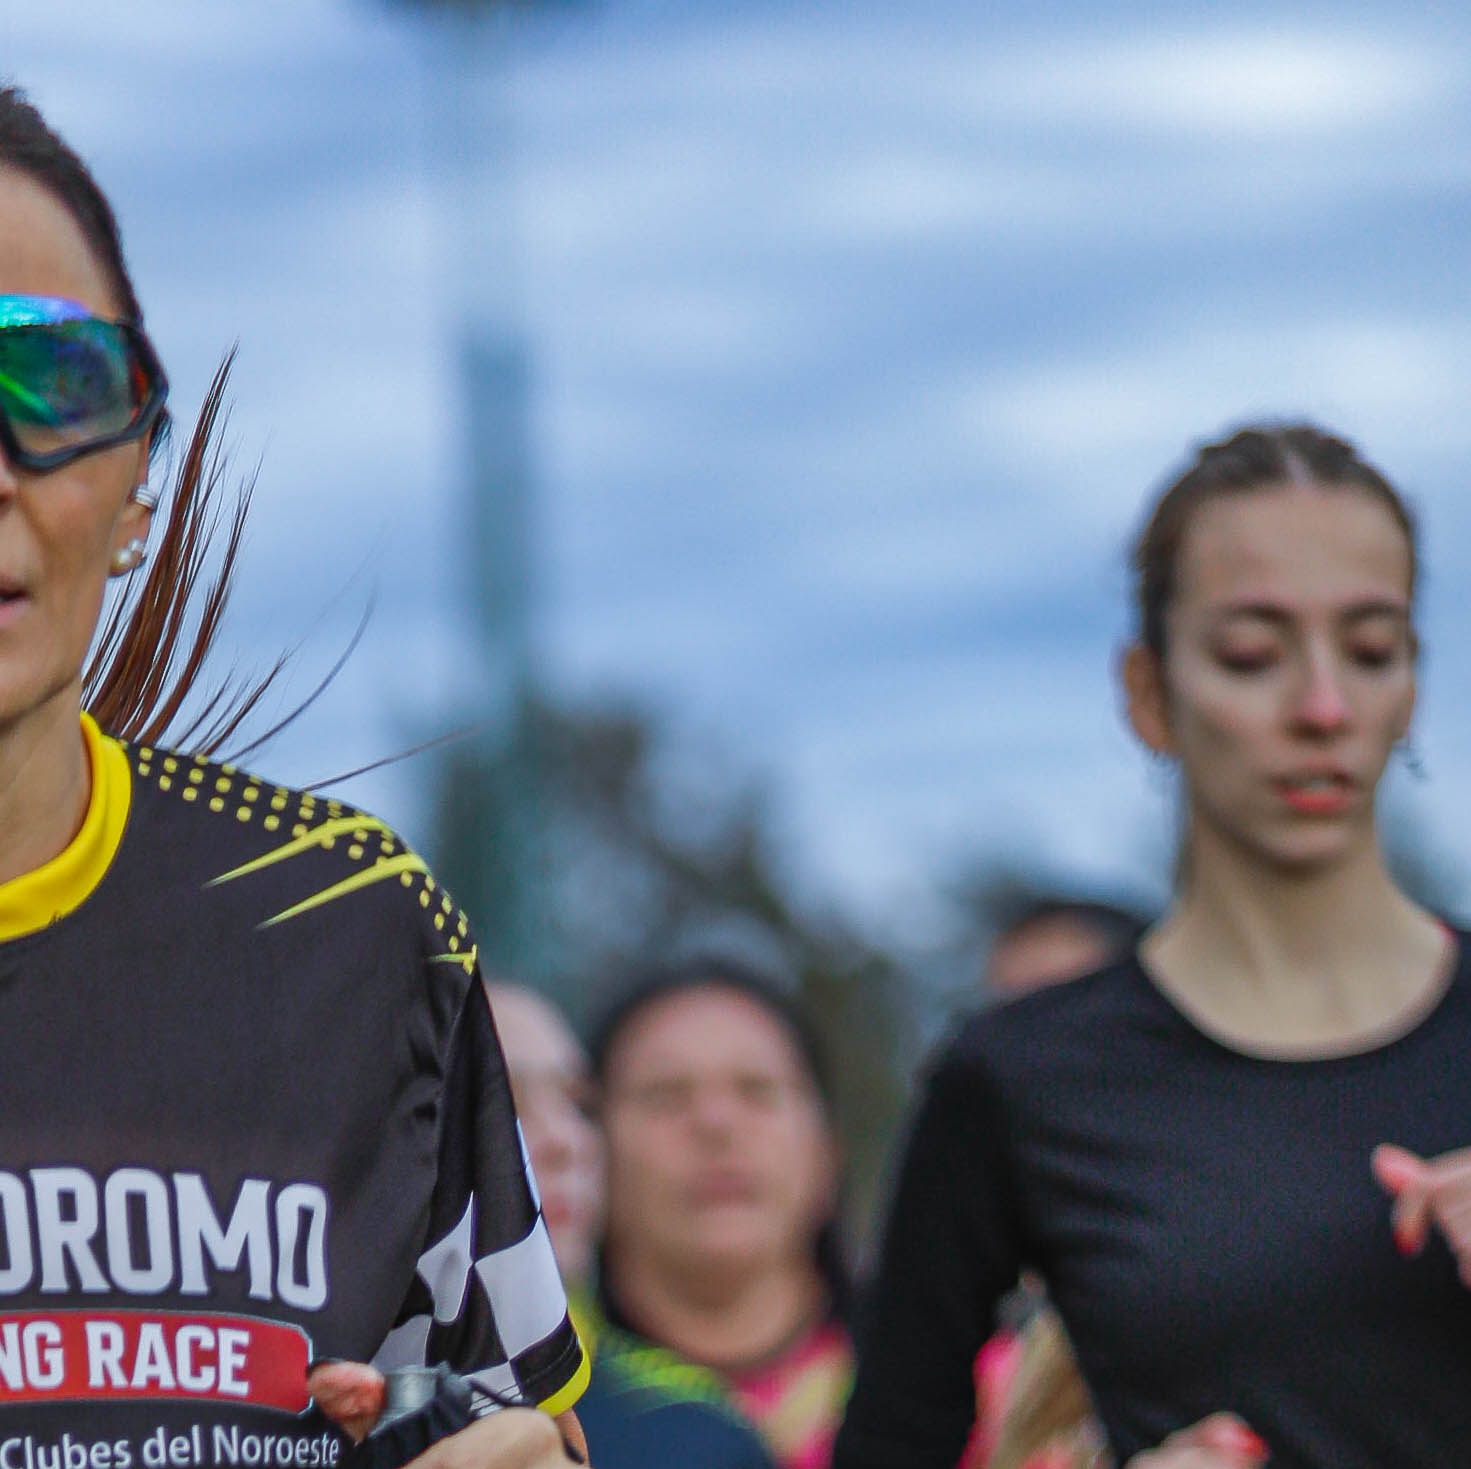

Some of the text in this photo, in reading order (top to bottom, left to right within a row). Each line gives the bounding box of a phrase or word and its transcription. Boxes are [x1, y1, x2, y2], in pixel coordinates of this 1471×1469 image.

[87, 1321, 252, 1396] RACE
[143, 1424, 200, 1466] del
[212, 1424, 340, 1468] Noroeste
